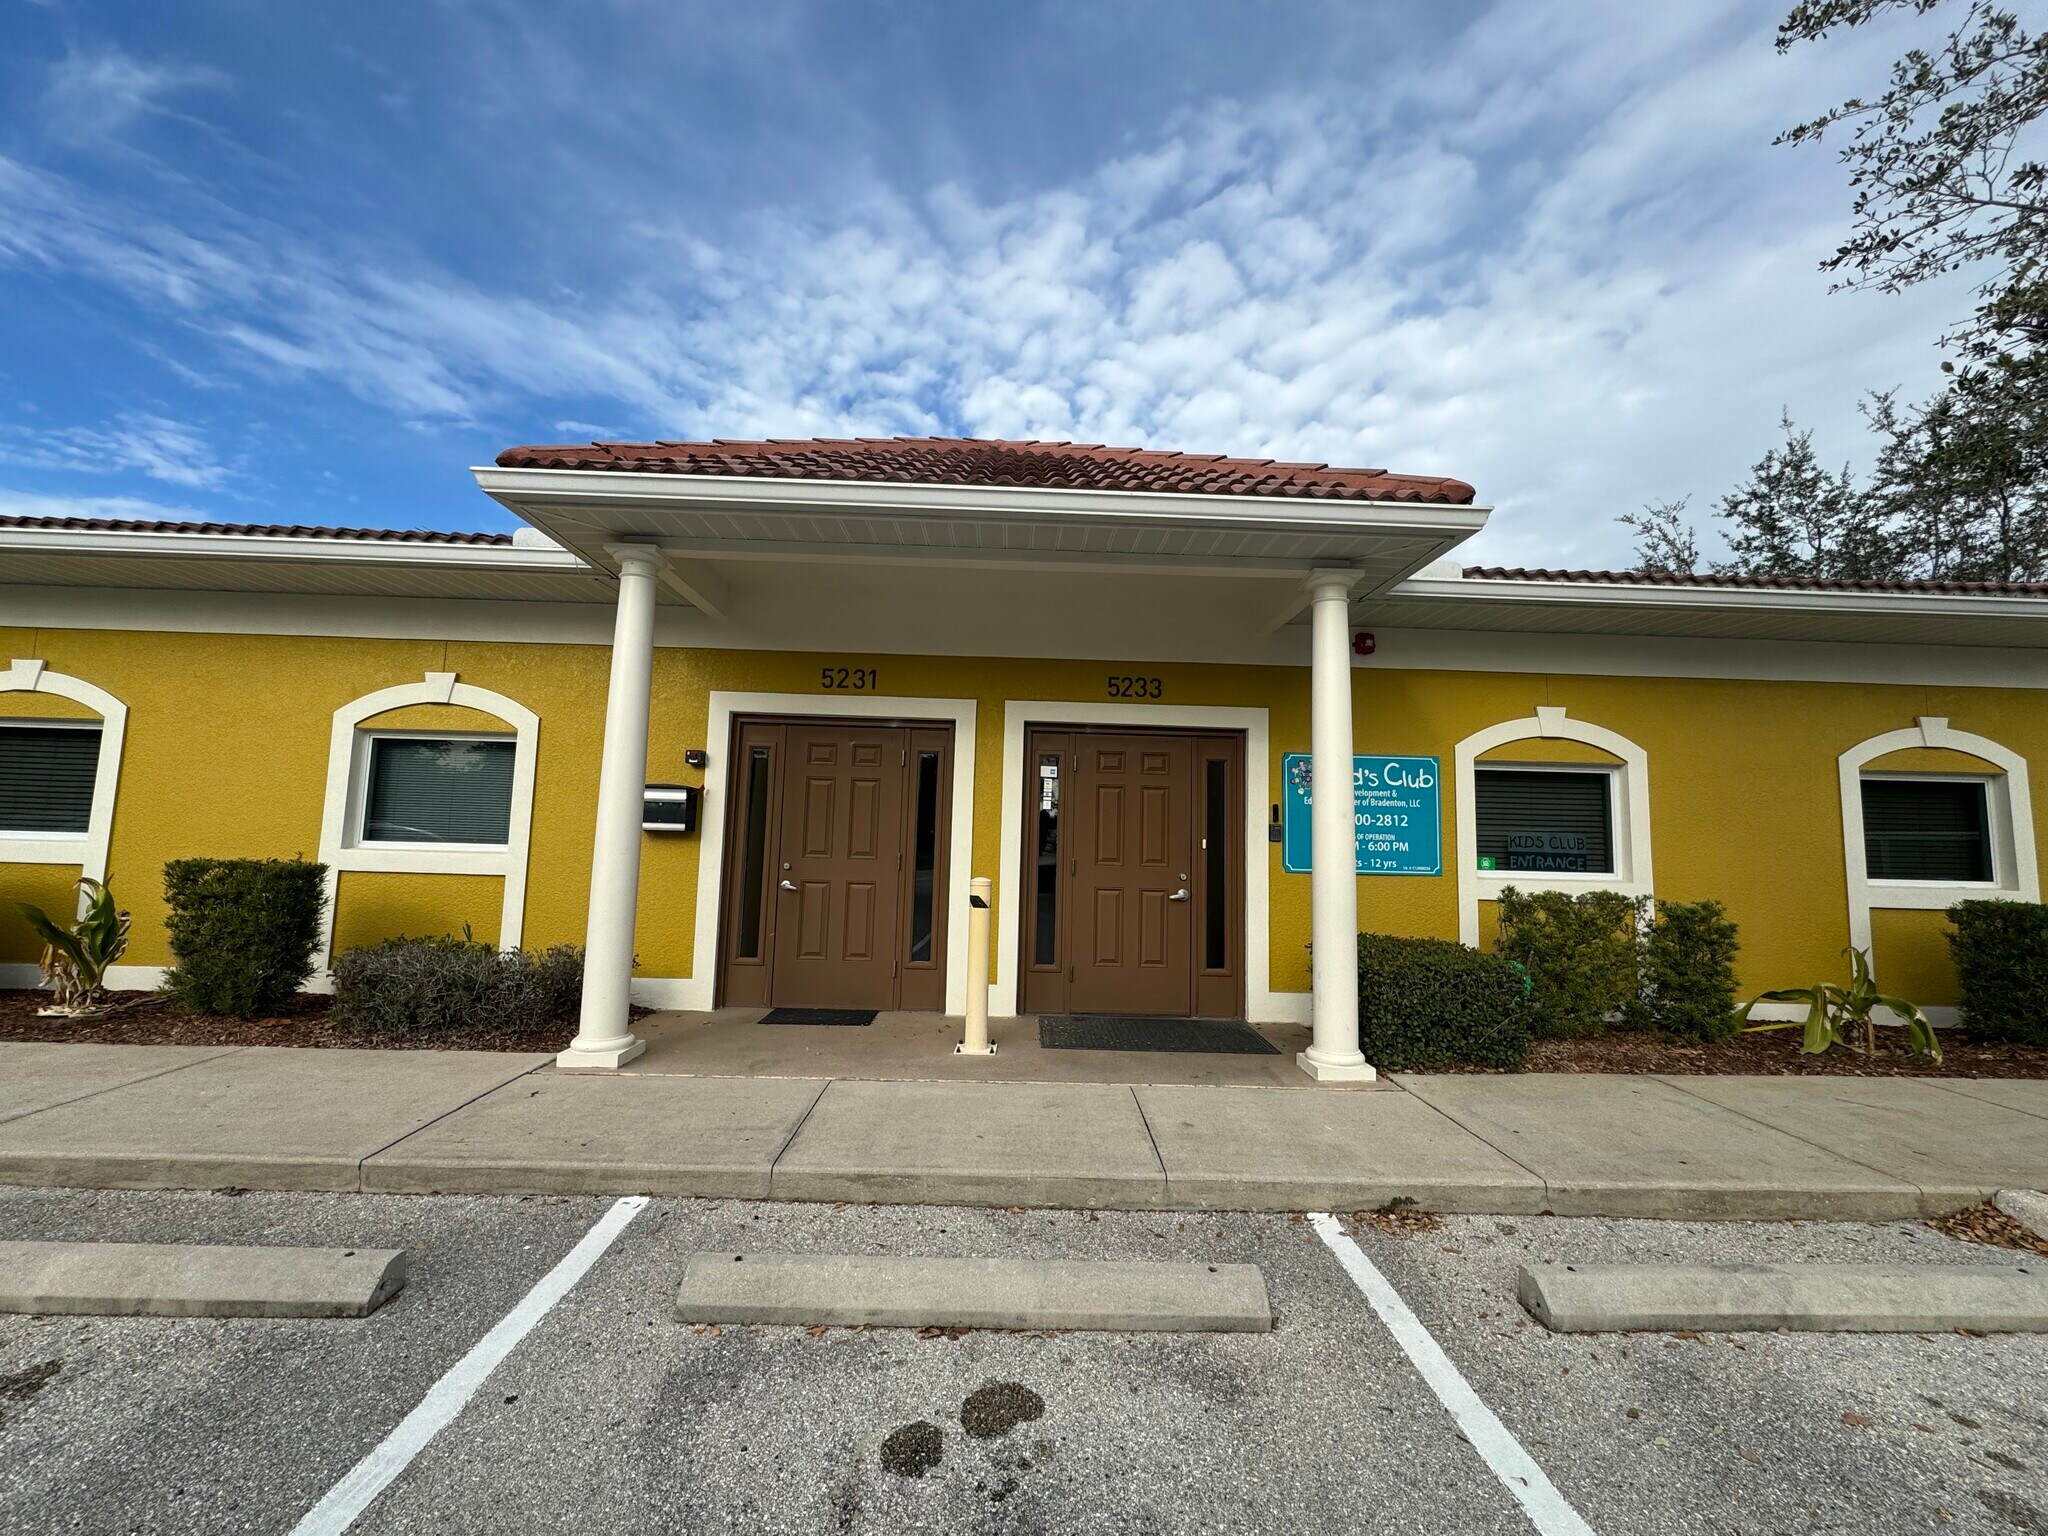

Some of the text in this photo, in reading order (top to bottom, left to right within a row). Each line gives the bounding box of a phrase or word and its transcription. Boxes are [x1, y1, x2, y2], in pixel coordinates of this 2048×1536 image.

[821, 667, 877, 690] 5231
[1107, 676, 1162, 699] 5233
[1353, 762, 1434, 789] d's Club
[1354, 788, 1398, 800] velopment &
[1361, 798, 1369, 806] of
[1370, 798, 1408, 808] Bradenton,
[1409, 799, 1421, 808] LLC
[1355, 813, 1409, 827] 00-2812
[1364, 833, 1396, 841] OPERATION
[1509, 835, 1586, 851] KIDS CLUB
[1367, 841, 1391, 852] 6:00
[1392, 841, 1409, 852] PM
[1370, 858, 1382, 868] 12
[1383, 860, 1397, 870] yrs
[1509, 854, 1586, 871] ENTRANCE
